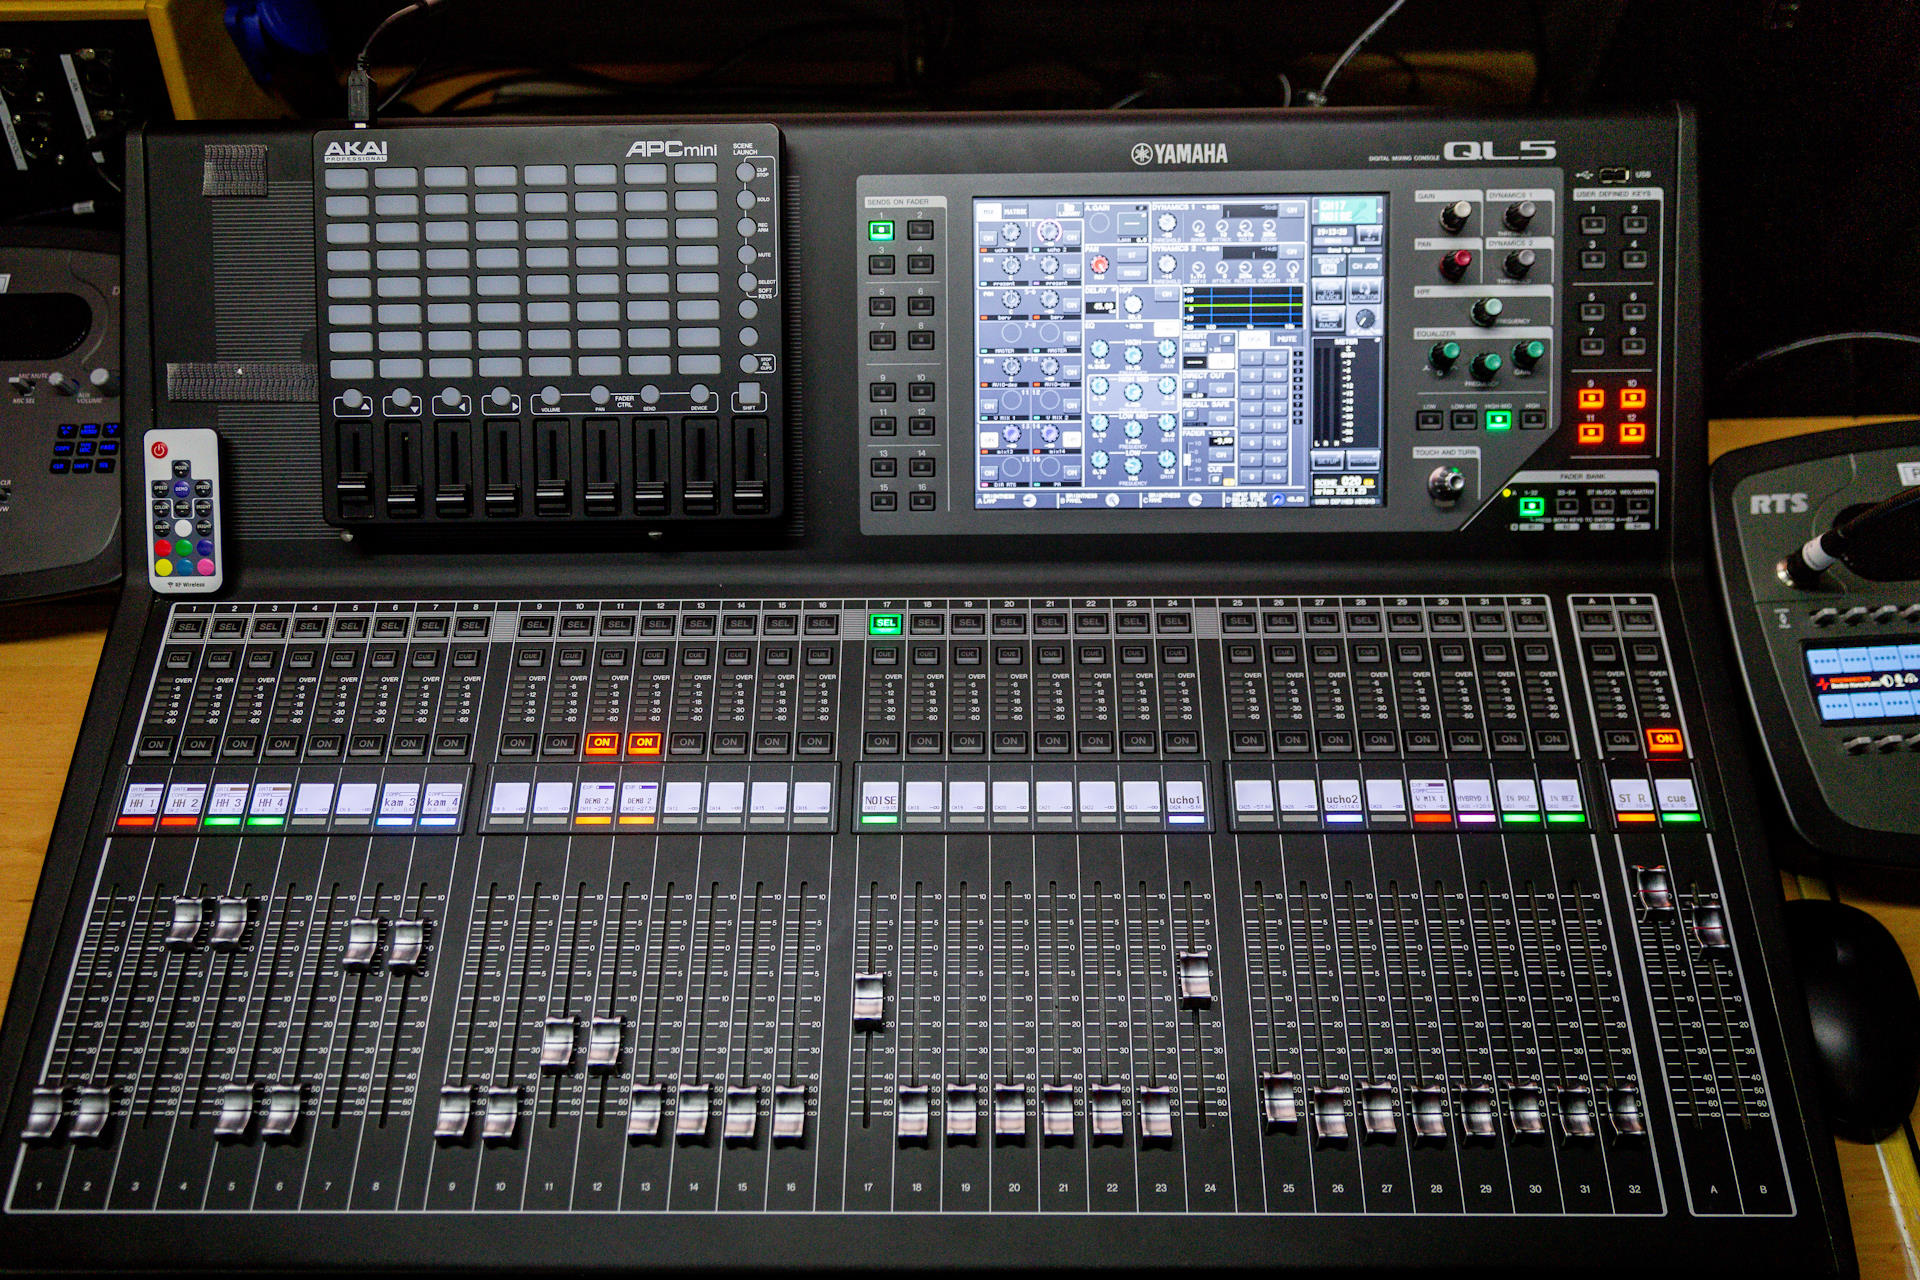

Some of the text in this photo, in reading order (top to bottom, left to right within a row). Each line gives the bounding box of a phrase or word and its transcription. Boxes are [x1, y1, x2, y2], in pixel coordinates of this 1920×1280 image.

[324, 141, 387, 155] AKAI
[1444, 141, 1556, 160] QL5
[1154, 143, 1228, 164] YAMAHA
[1586, 414, 1595, 422] 11
[1750, 493, 1809, 514] RTS
[877, 619, 896, 627] SEL
[443, 739, 459, 747] ON
[510, 738, 525, 747] ON
[552, 738, 568, 746] ON
[594, 738, 610, 746] ON
[637, 738, 652, 746] ON
[680, 738, 695, 746] ON
[722, 738, 737, 746] ON
[765, 738, 780, 746] ON
[807, 738, 822, 746] ON
[1656, 735, 1674, 743] ON
[190, 740, 205, 748] ON
[232, 740, 248, 748] ON
[274, 740, 290, 748] ON
[316, 740, 332, 748] ON
[129, 798, 144, 808] HH
[173, 798, 187, 808] HH
[216, 798, 231, 808] HH
[258, 798, 273, 808] HH
[385, 796, 404, 807] kam
[427, 796, 447, 807] kam
[865, 796, 897, 805] NOISE
[37, 1182, 42, 1190] 1
[83, 1182, 91, 1191] 2
[132, 1182, 139, 1191] 3
[180, 1182, 187, 1190] 4
[229, 1182, 235, 1191] 5
[276, 1182, 283, 1191] 6
[325, 1182, 331, 1190] 7
[373, 1182, 379, 1191] 8
[449, 1182, 455, 1191] 9
[496, 1182, 506, 1191] 10
[593, 1182, 602, 1191] 12
[642, 1182, 650, 1191] 13
[690, 1183, 698, 1191] 14
[738, 1183, 747, 1191] 15
[787, 1183, 795, 1191] 16
[864, 1183, 873, 1191] 17
[913, 1183, 921, 1191] 18
[961, 1183, 970, 1192] 19
[1009, 1183, 1020, 1192] 20
[1059, 1184, 1068, 1192] 21
[1107, 1184, 1118, 1192] 22
[1156, 1184, 1167, 1192] 23
[1205, 1184, 1216, 1192] 24
[1283, 1184, 1294, 1192] 25
[1332, 1184, 1344, 1192] 26
[1382, 1184, 1392, 1193] 27
[1431, 1184, 1442, 1193] 28
[1480, 1185, 1492, 1193] 29
[1530, 1185, 1542, 1193] 30
[1580, 1185, 1590, 1193] 31
[1629, 1185, 1641, 1193] 32
[1711, 1185, 1718, 1193] A
[1760, 1185, 1767, 1193] B
